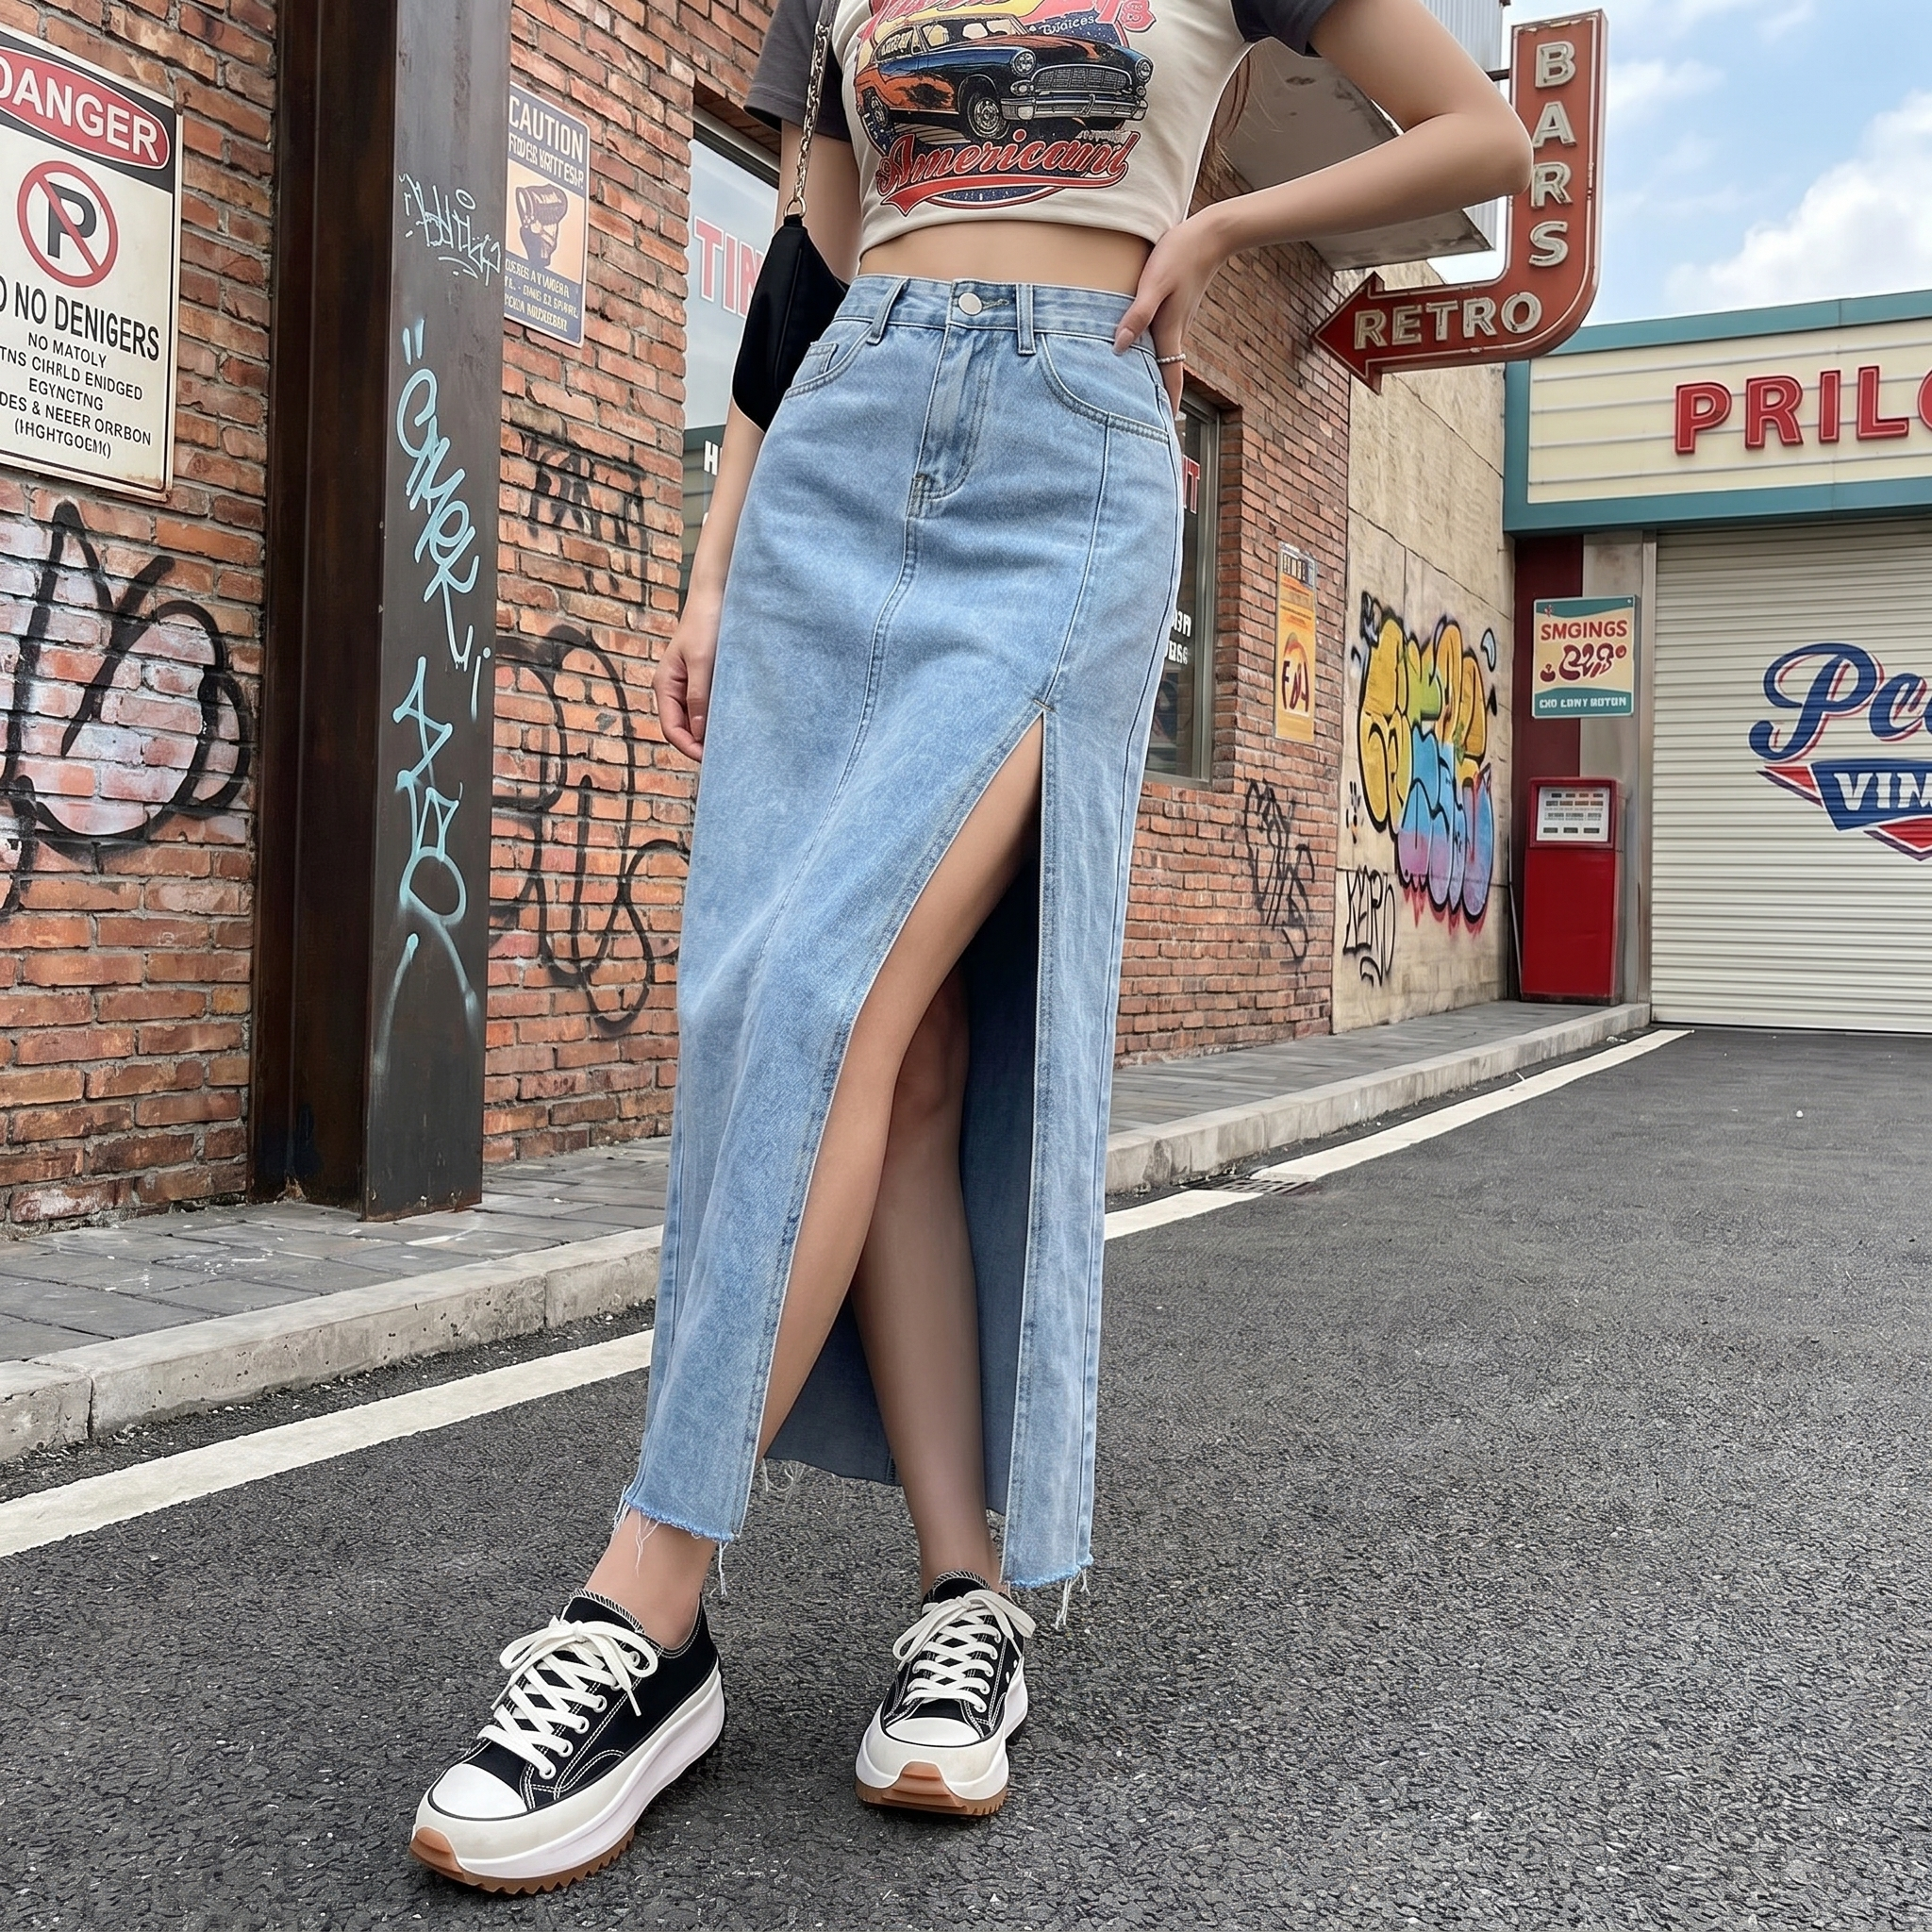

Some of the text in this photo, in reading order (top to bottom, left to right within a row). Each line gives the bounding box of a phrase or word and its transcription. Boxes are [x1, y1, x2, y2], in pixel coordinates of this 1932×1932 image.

[509, 94, 583, 163] CAUTION
[1528, 41, 1576, 267] BARS
[15, 281, 47, 325] NO
[55, 294, 159, 361] DENIGERS
[1354, 291, 1542, 350] RETRO
[28, 332, 107, 369] NO MATOLY
[85, 372, 142, 401] ENIDGED
[1674, 364, 1932, 454] PRIL
[31, 400, 41, 416] &
[45, 404, 91, 430] NEEER
[94, 418, 151, 445] ORRBON
[1541, 620, 1627, 641] SMGINGS
